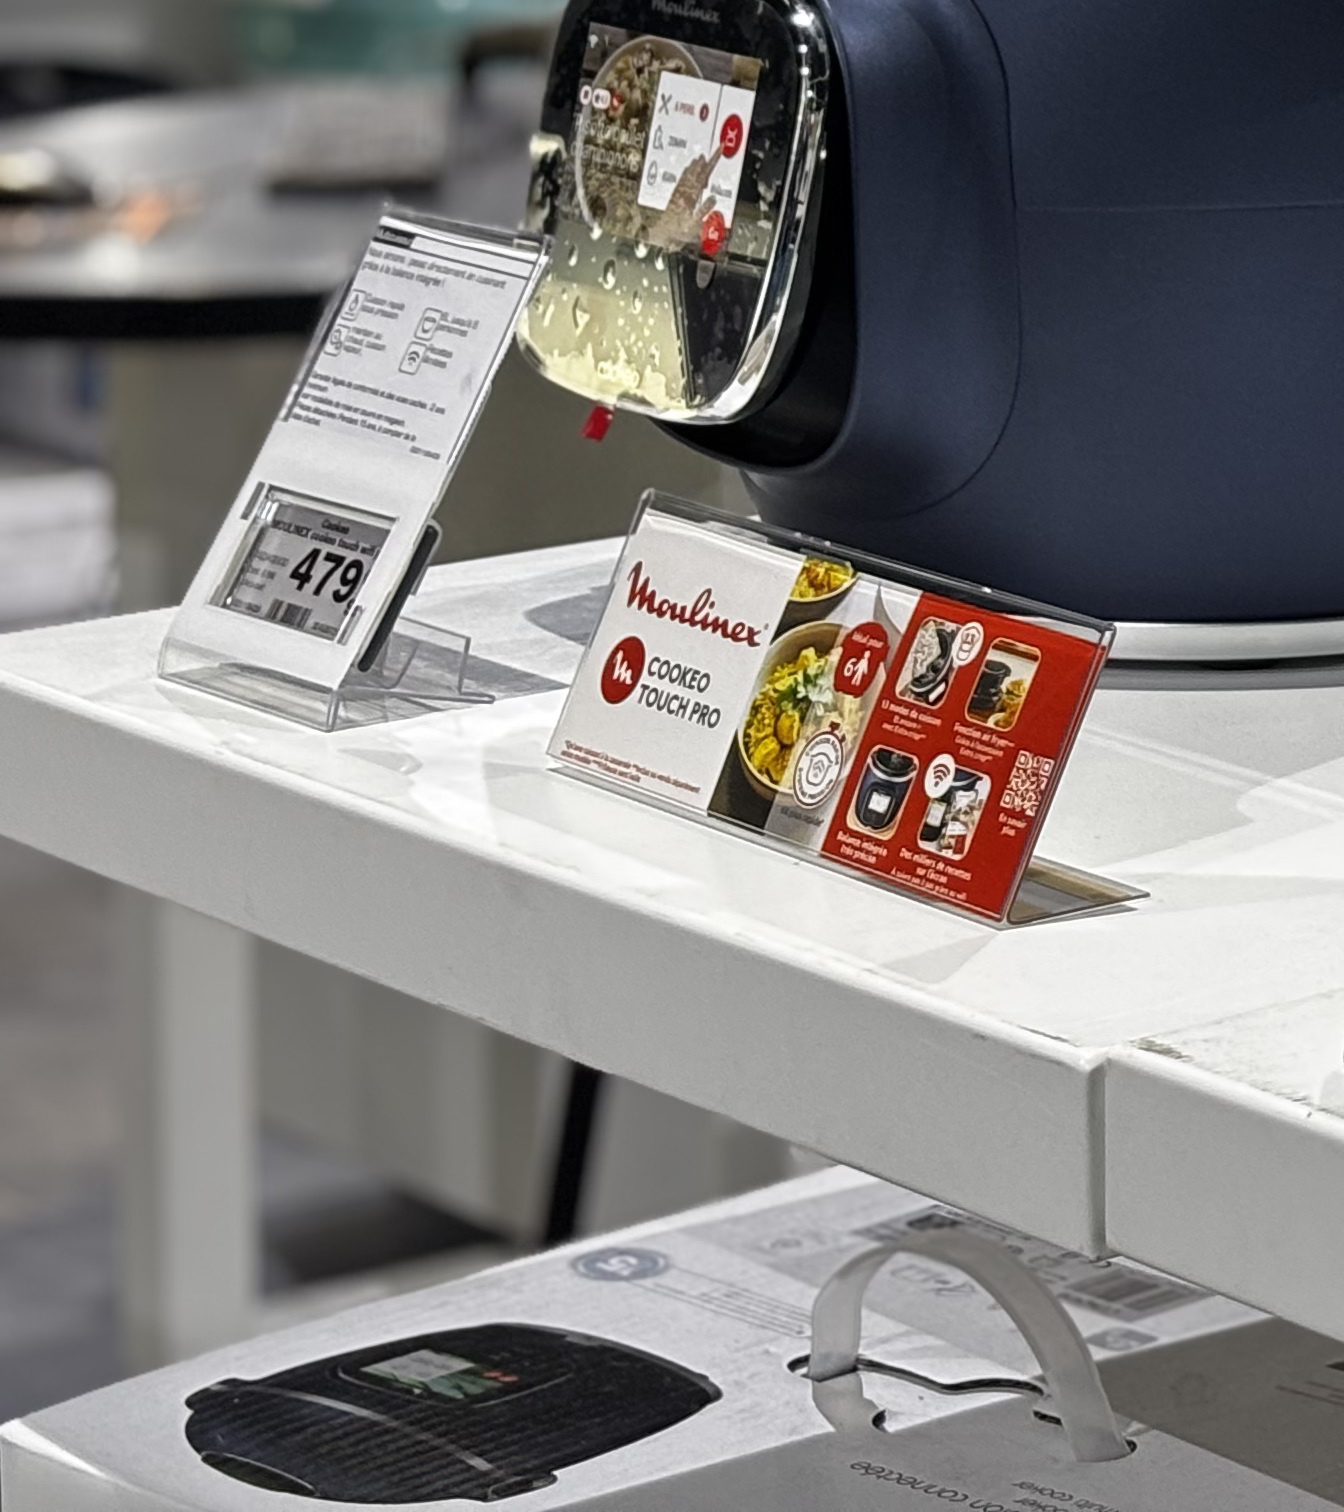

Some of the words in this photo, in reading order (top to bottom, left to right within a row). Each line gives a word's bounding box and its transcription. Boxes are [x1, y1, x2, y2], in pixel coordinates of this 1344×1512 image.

[289, 548, 364, 603] 479
[627, 561, 762, 647] Moulinex
[647, 656, 711, 694] COOKEO
[638, 684, 688, 720] TOUCH
[687, 701, 722, 729] PRO
[850, 1461, 969, 1503] connectée
[1011, 1482, 1074, 1502] cooker
